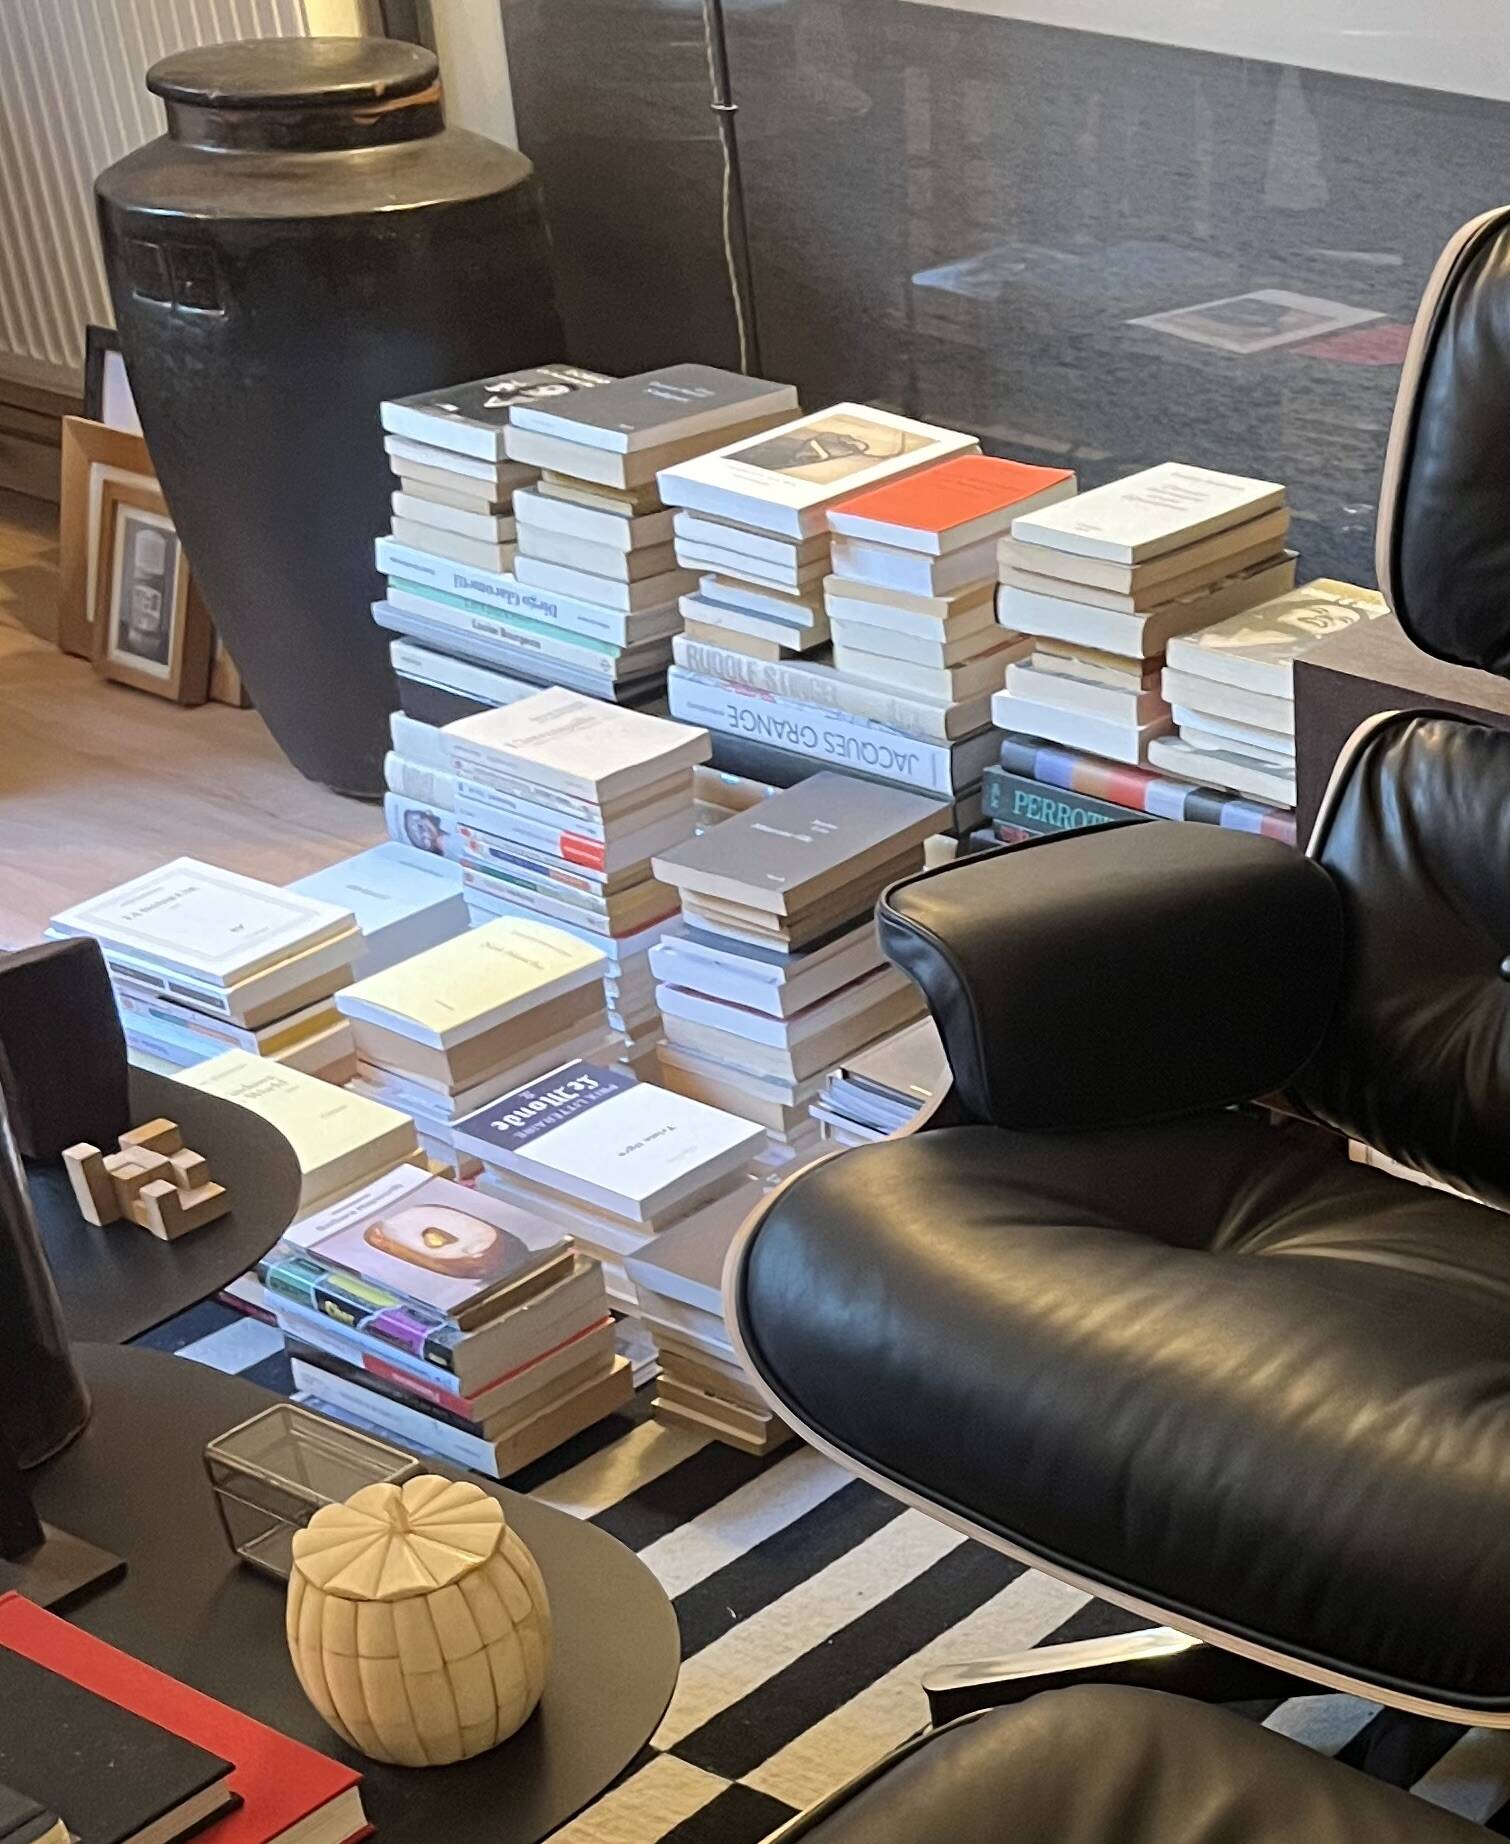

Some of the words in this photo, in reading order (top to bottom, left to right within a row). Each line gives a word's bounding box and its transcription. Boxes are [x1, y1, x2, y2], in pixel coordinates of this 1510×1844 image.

[726, 703, 818, 749] GRANGE
[823, 731, 920, 775] JACQUES
[1012, 789, 1115, 830] PERROT
[567, 1073, 599, 1090] Le
[490, 1086, 579, 1131] Monde
